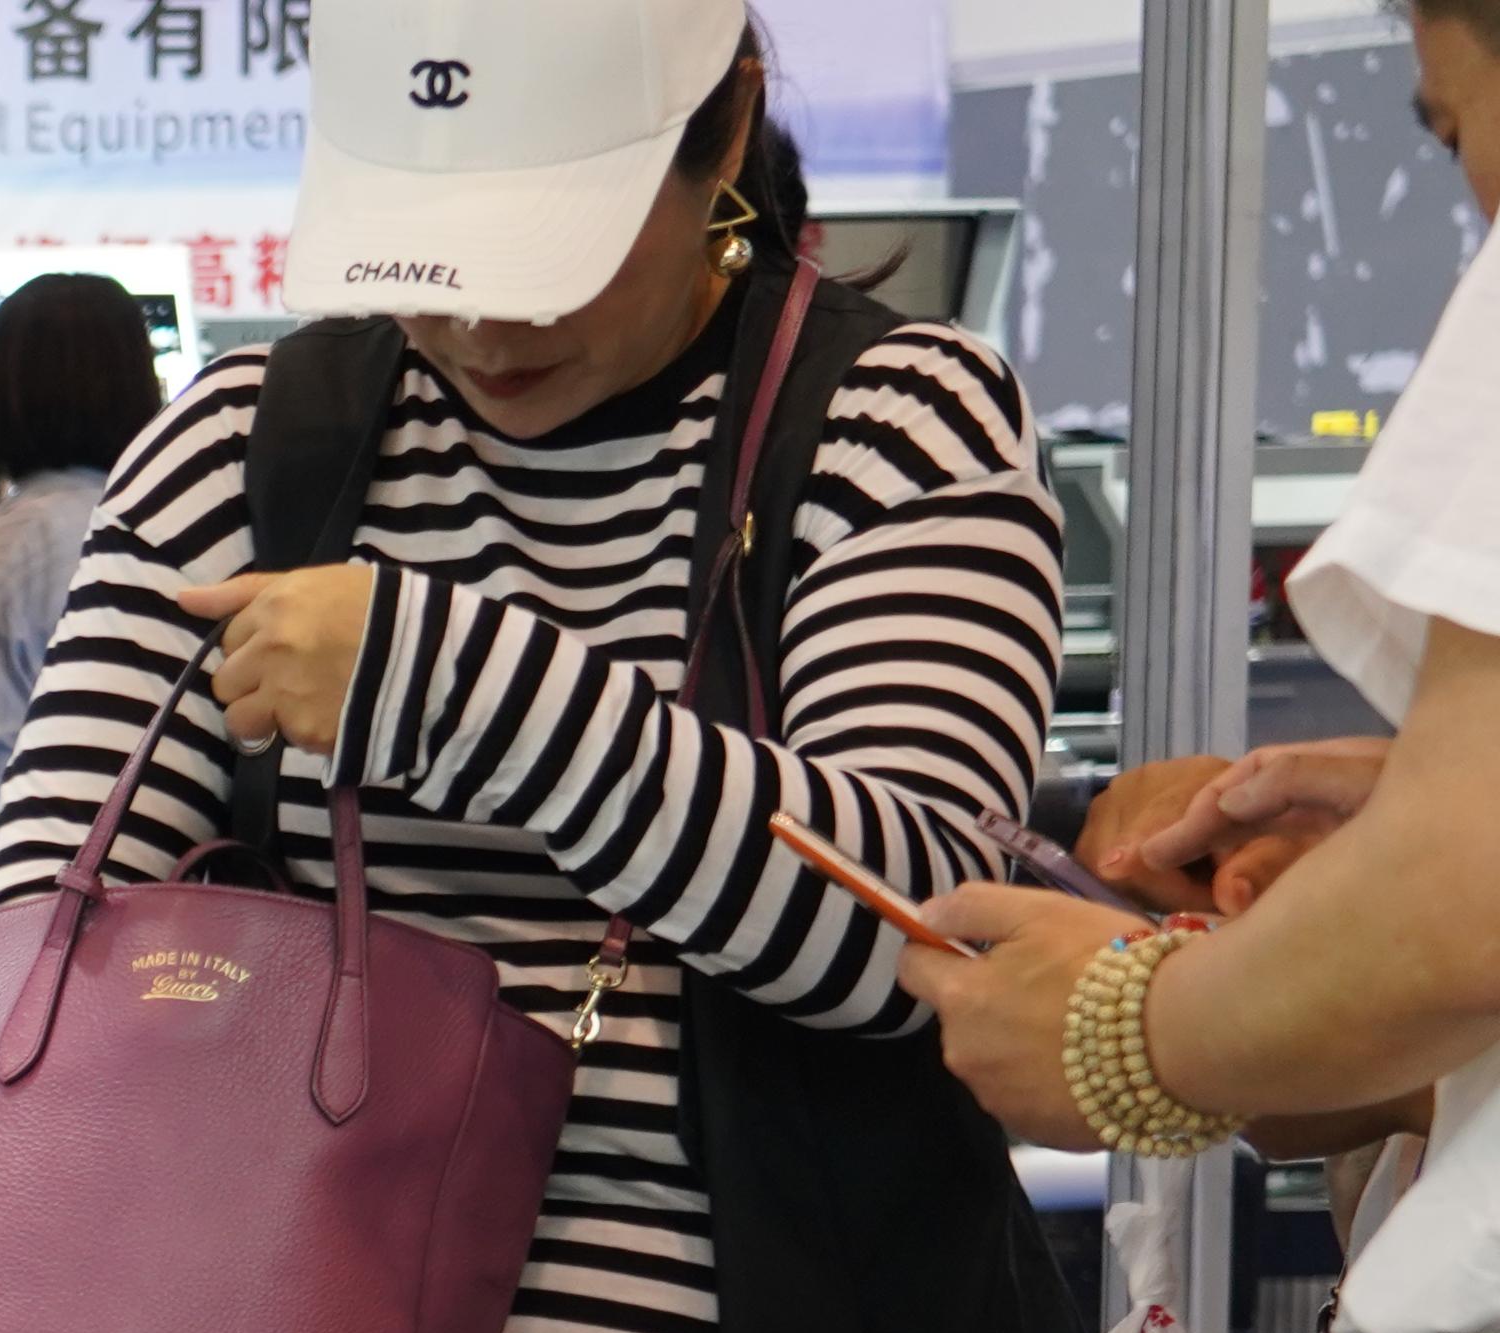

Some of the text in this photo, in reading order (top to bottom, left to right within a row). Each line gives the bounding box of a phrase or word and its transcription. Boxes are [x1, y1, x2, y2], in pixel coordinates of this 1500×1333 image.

[344, 259, 464, 291] CHANEL
[132, 951, 252, 984] MADE IN ITALY
[177, 968, 198, 980] BY
[140, 974, 219, 1002] Gucci
